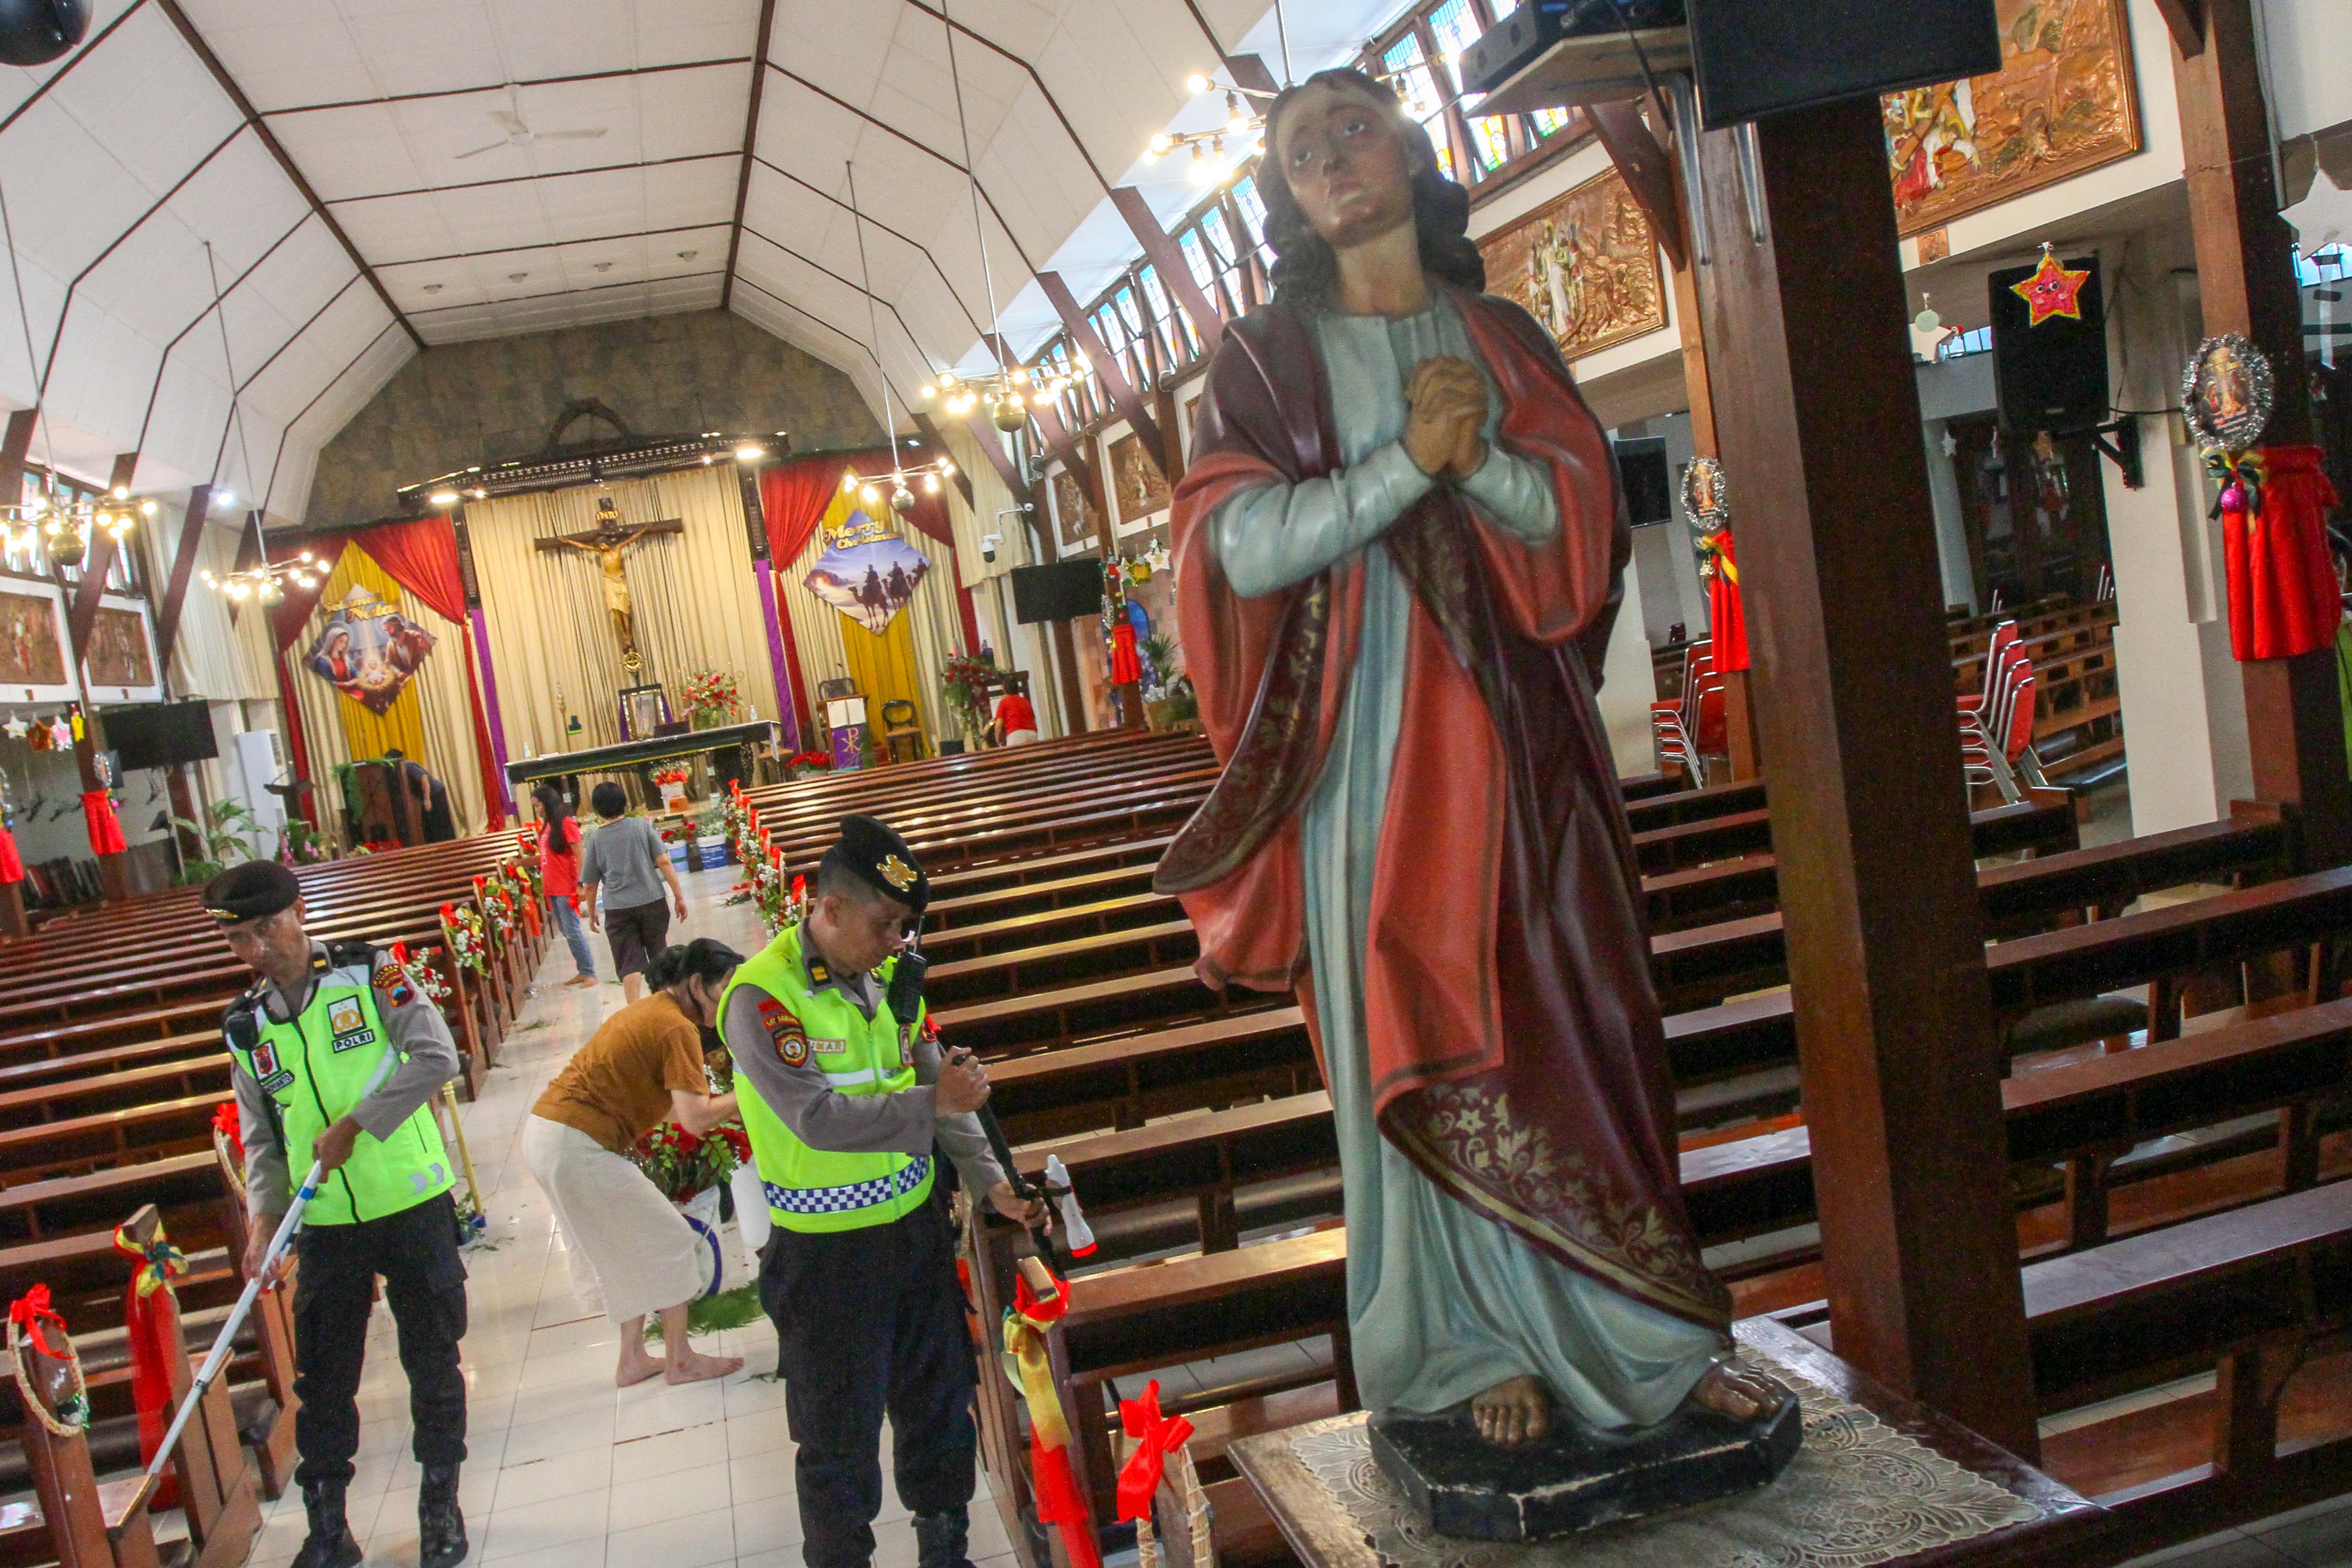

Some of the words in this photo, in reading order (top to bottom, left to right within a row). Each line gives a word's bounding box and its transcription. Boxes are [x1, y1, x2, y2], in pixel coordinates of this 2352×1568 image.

[596, 510, 619, 520] INRI
[823, 519, 885, 542] Merry
[836, 533, 898, 549] Christmas
[336, 1033, 371, 1049] POLRI
